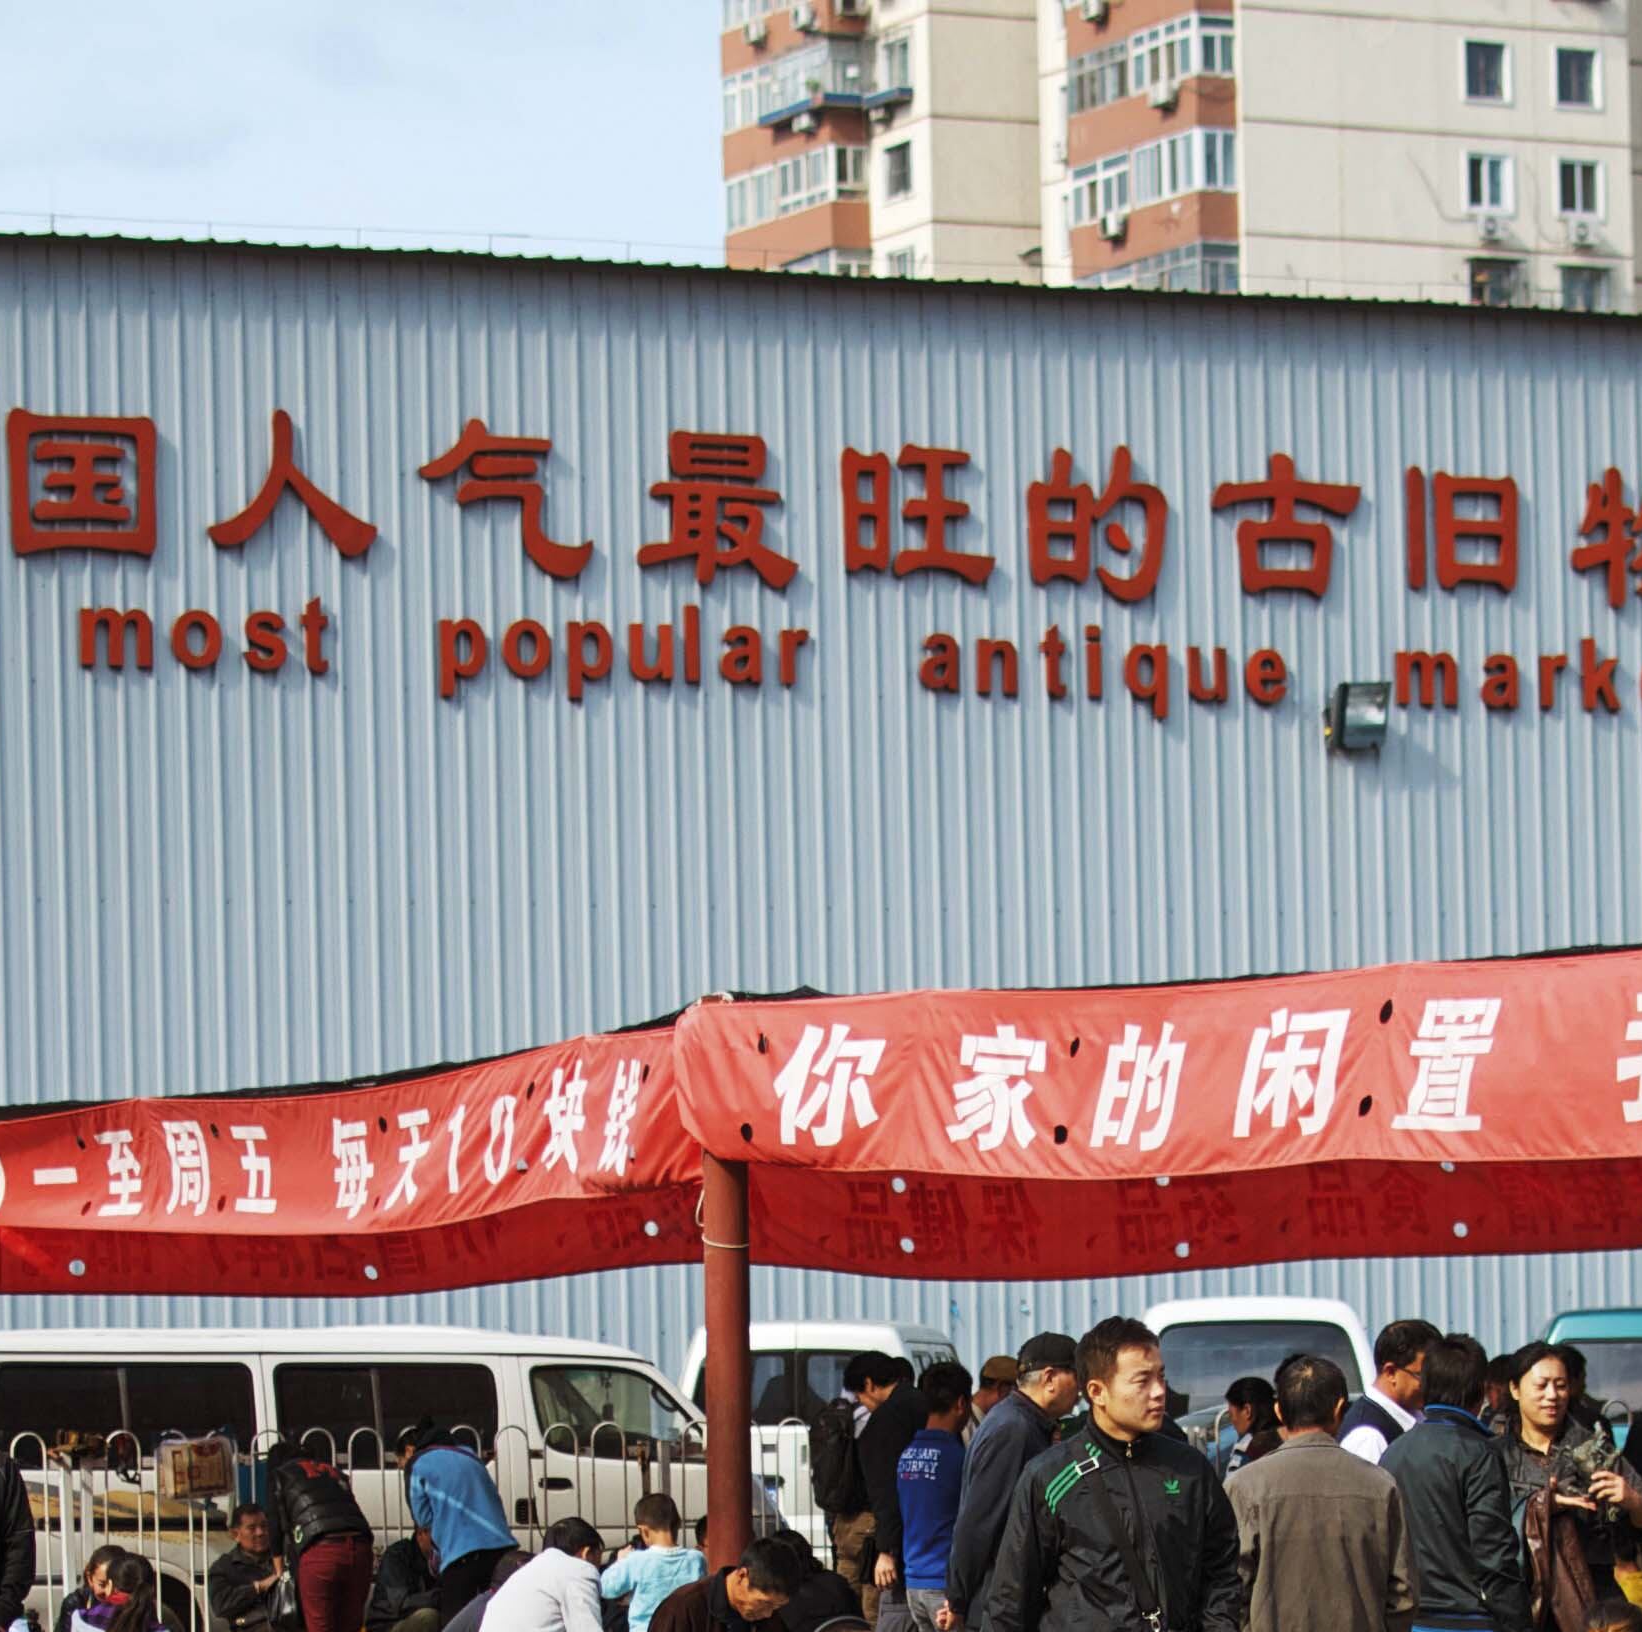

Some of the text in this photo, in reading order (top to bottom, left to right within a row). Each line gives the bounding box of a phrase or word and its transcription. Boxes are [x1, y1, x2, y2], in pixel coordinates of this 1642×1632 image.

[78, 597, 329, 674] most
[438, 603, 809, 700] popular
[918, 623, 1288, 719] antique
[770, 994, 1505, 1155] 你家的闲置
